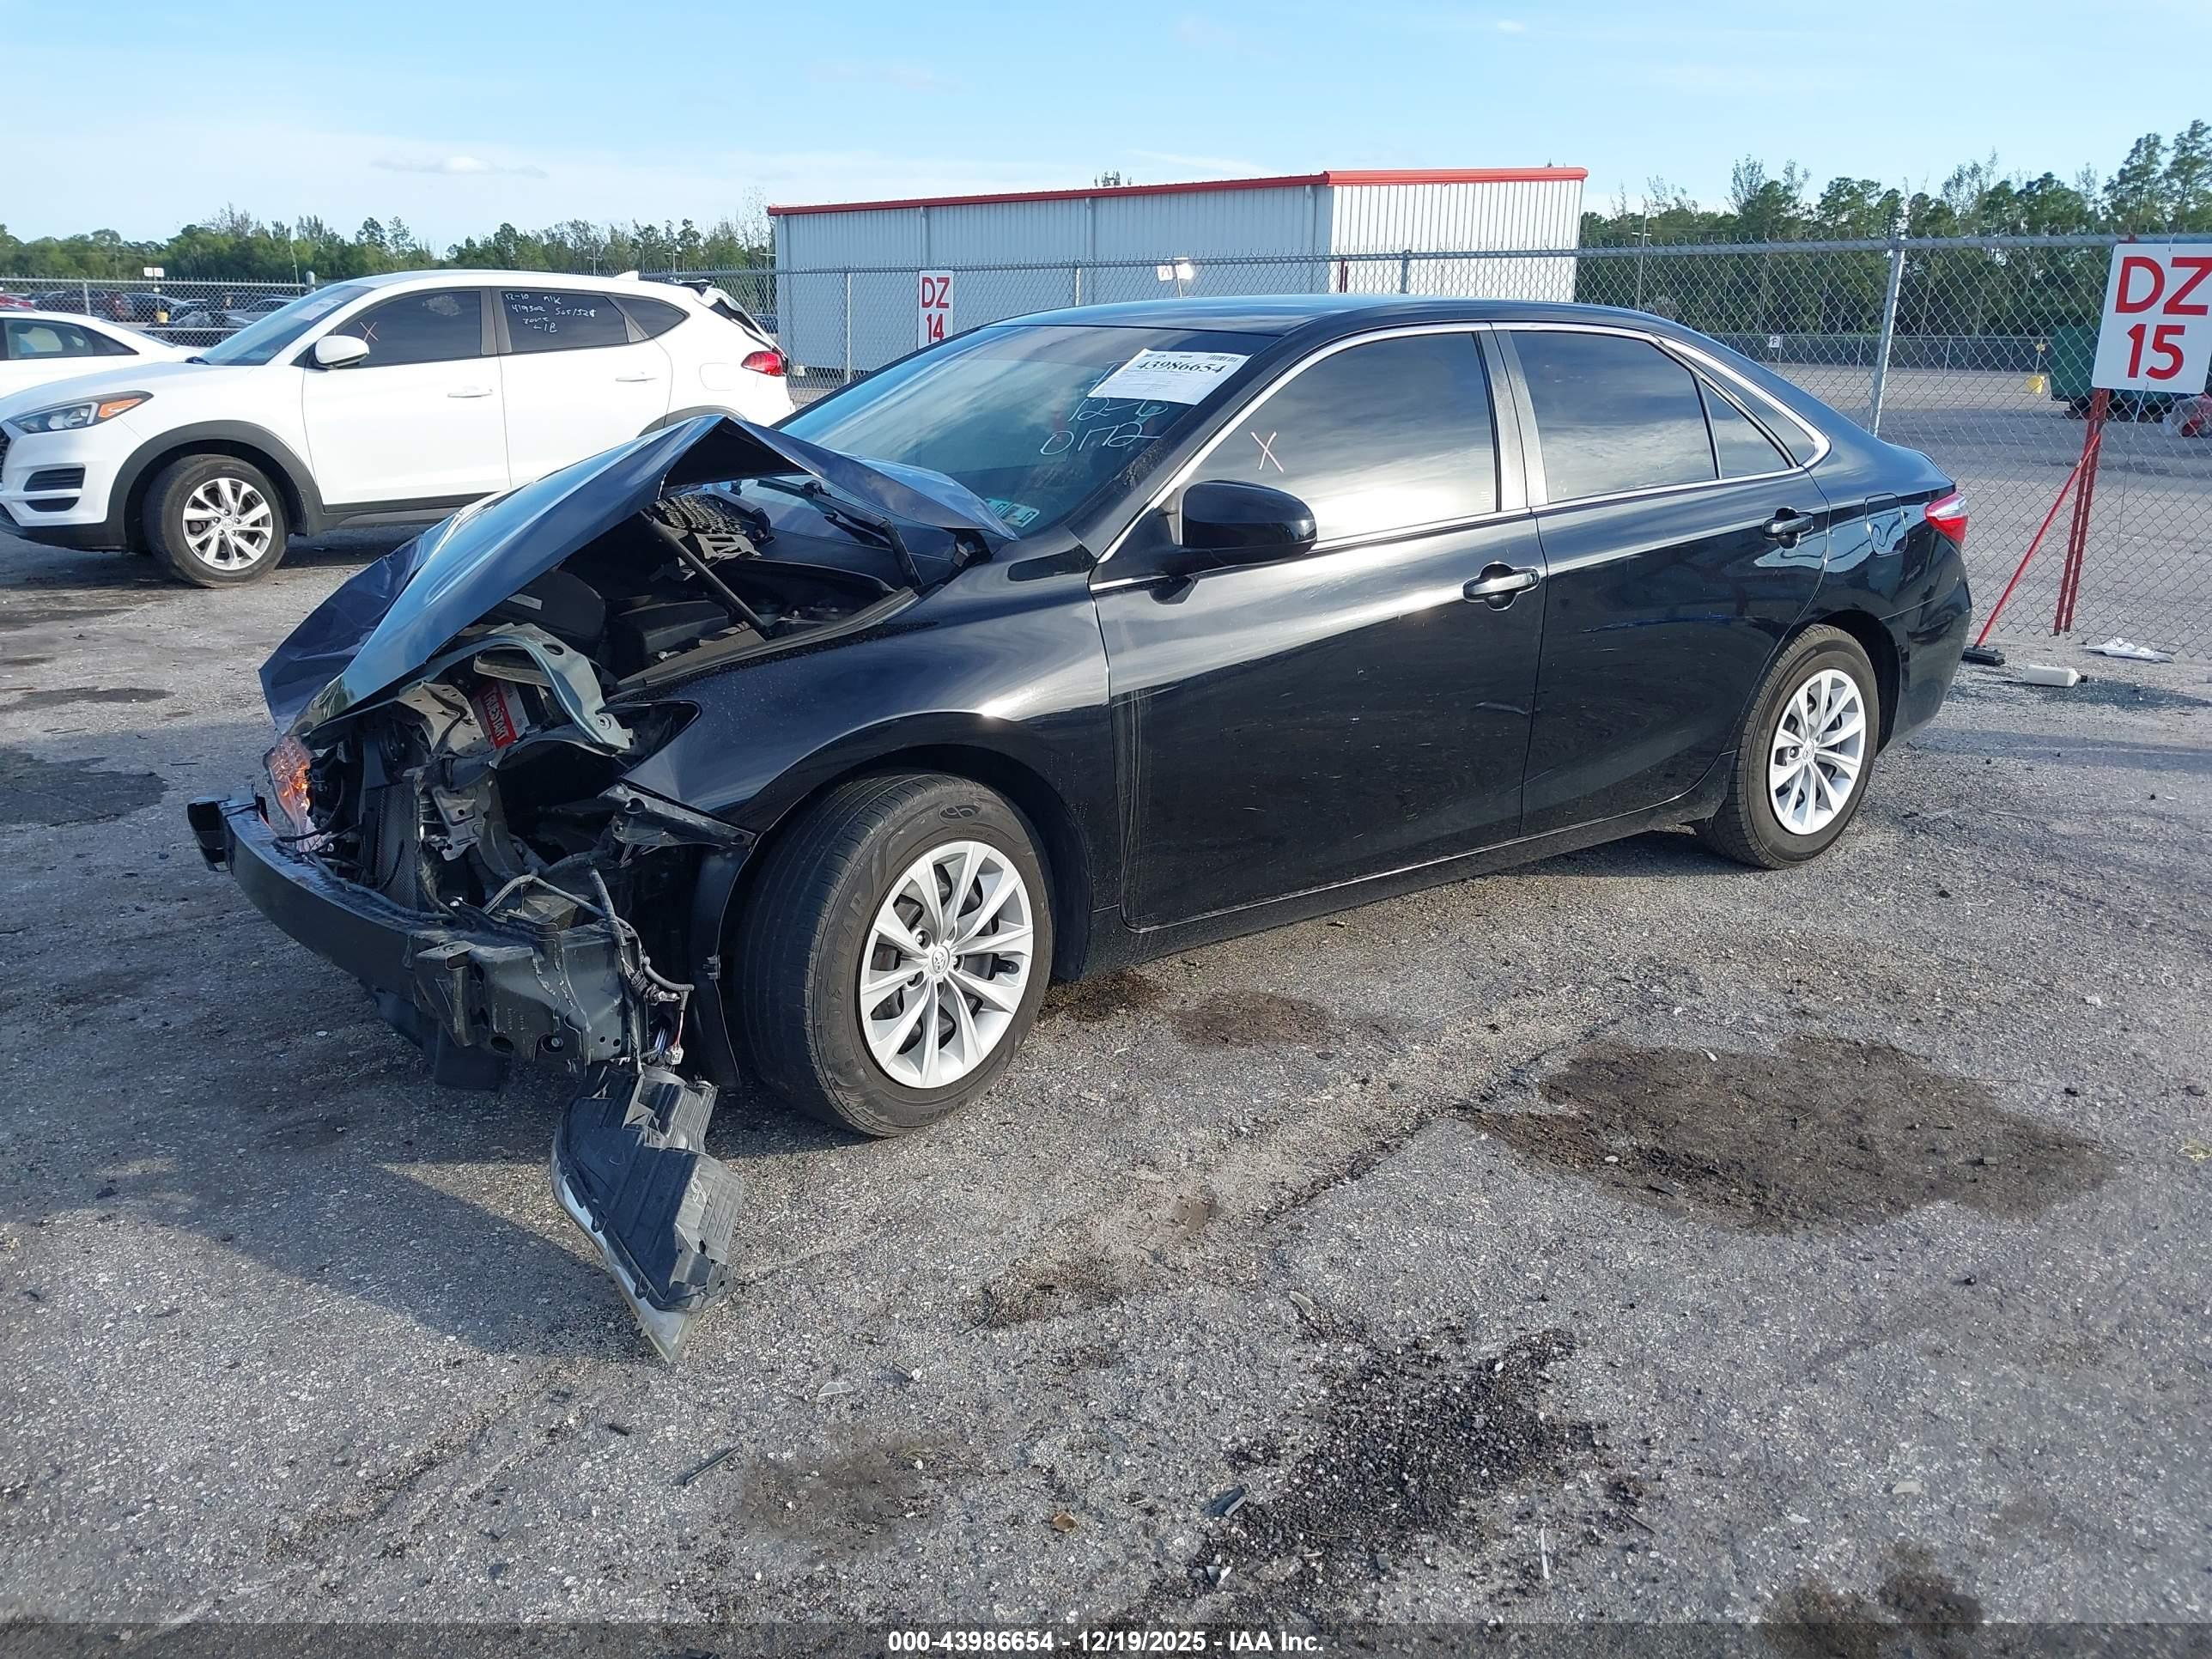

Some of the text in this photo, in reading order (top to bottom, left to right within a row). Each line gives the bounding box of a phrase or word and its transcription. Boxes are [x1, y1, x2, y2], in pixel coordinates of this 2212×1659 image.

[921, 276, 950, 309] DZ
[2115, 257, 2212, 316] DZ
[927, 313, 944, 343] 14
[1137, 361, 1226, 374] 43986654
[2127, 324, 2185, 380] 15
